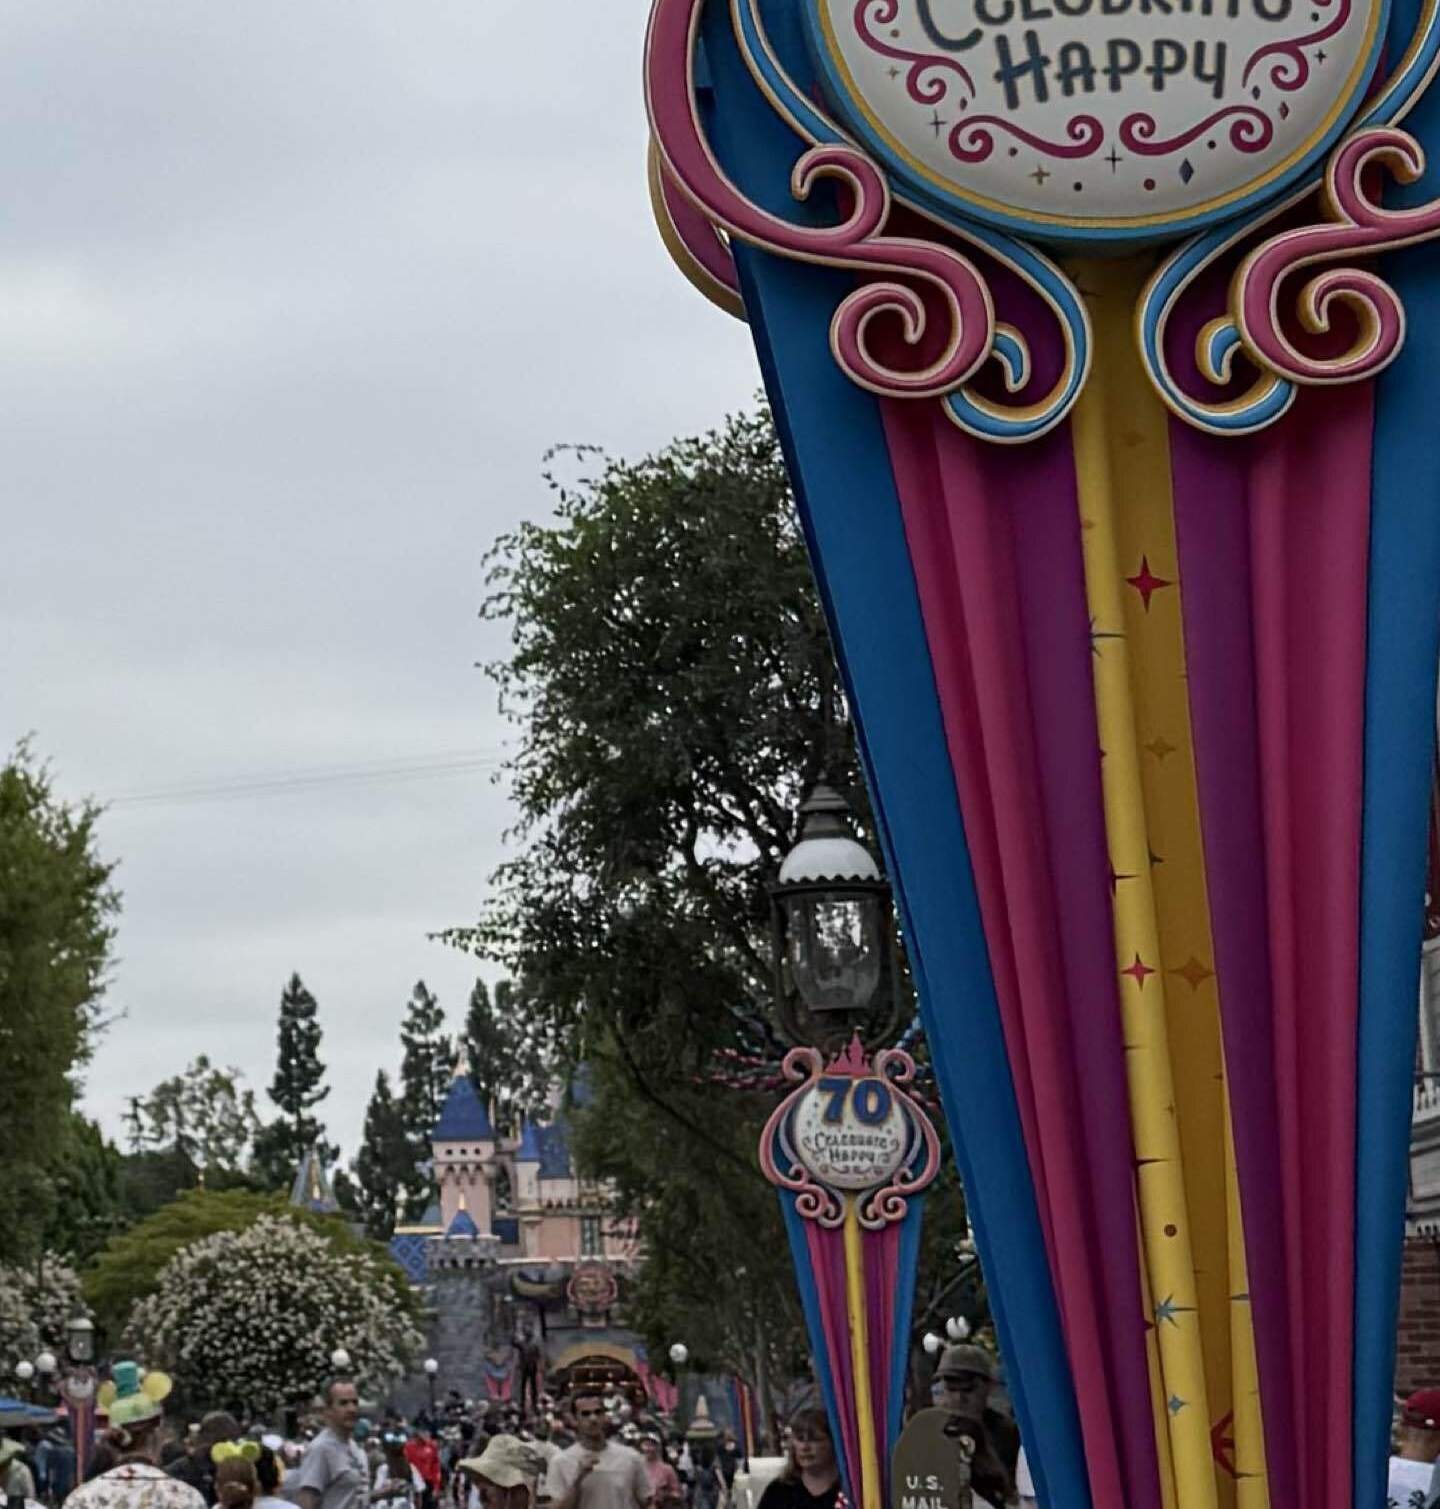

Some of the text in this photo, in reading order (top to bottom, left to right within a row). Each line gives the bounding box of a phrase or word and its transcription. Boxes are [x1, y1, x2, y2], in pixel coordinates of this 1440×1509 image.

[994, 29, 1227, 110] HAPPY
[817, 1078, 892, 1123] 70
[905, 1475, 944, 1491] U.S.
[901, 1496, 949, 1509] MAIL
